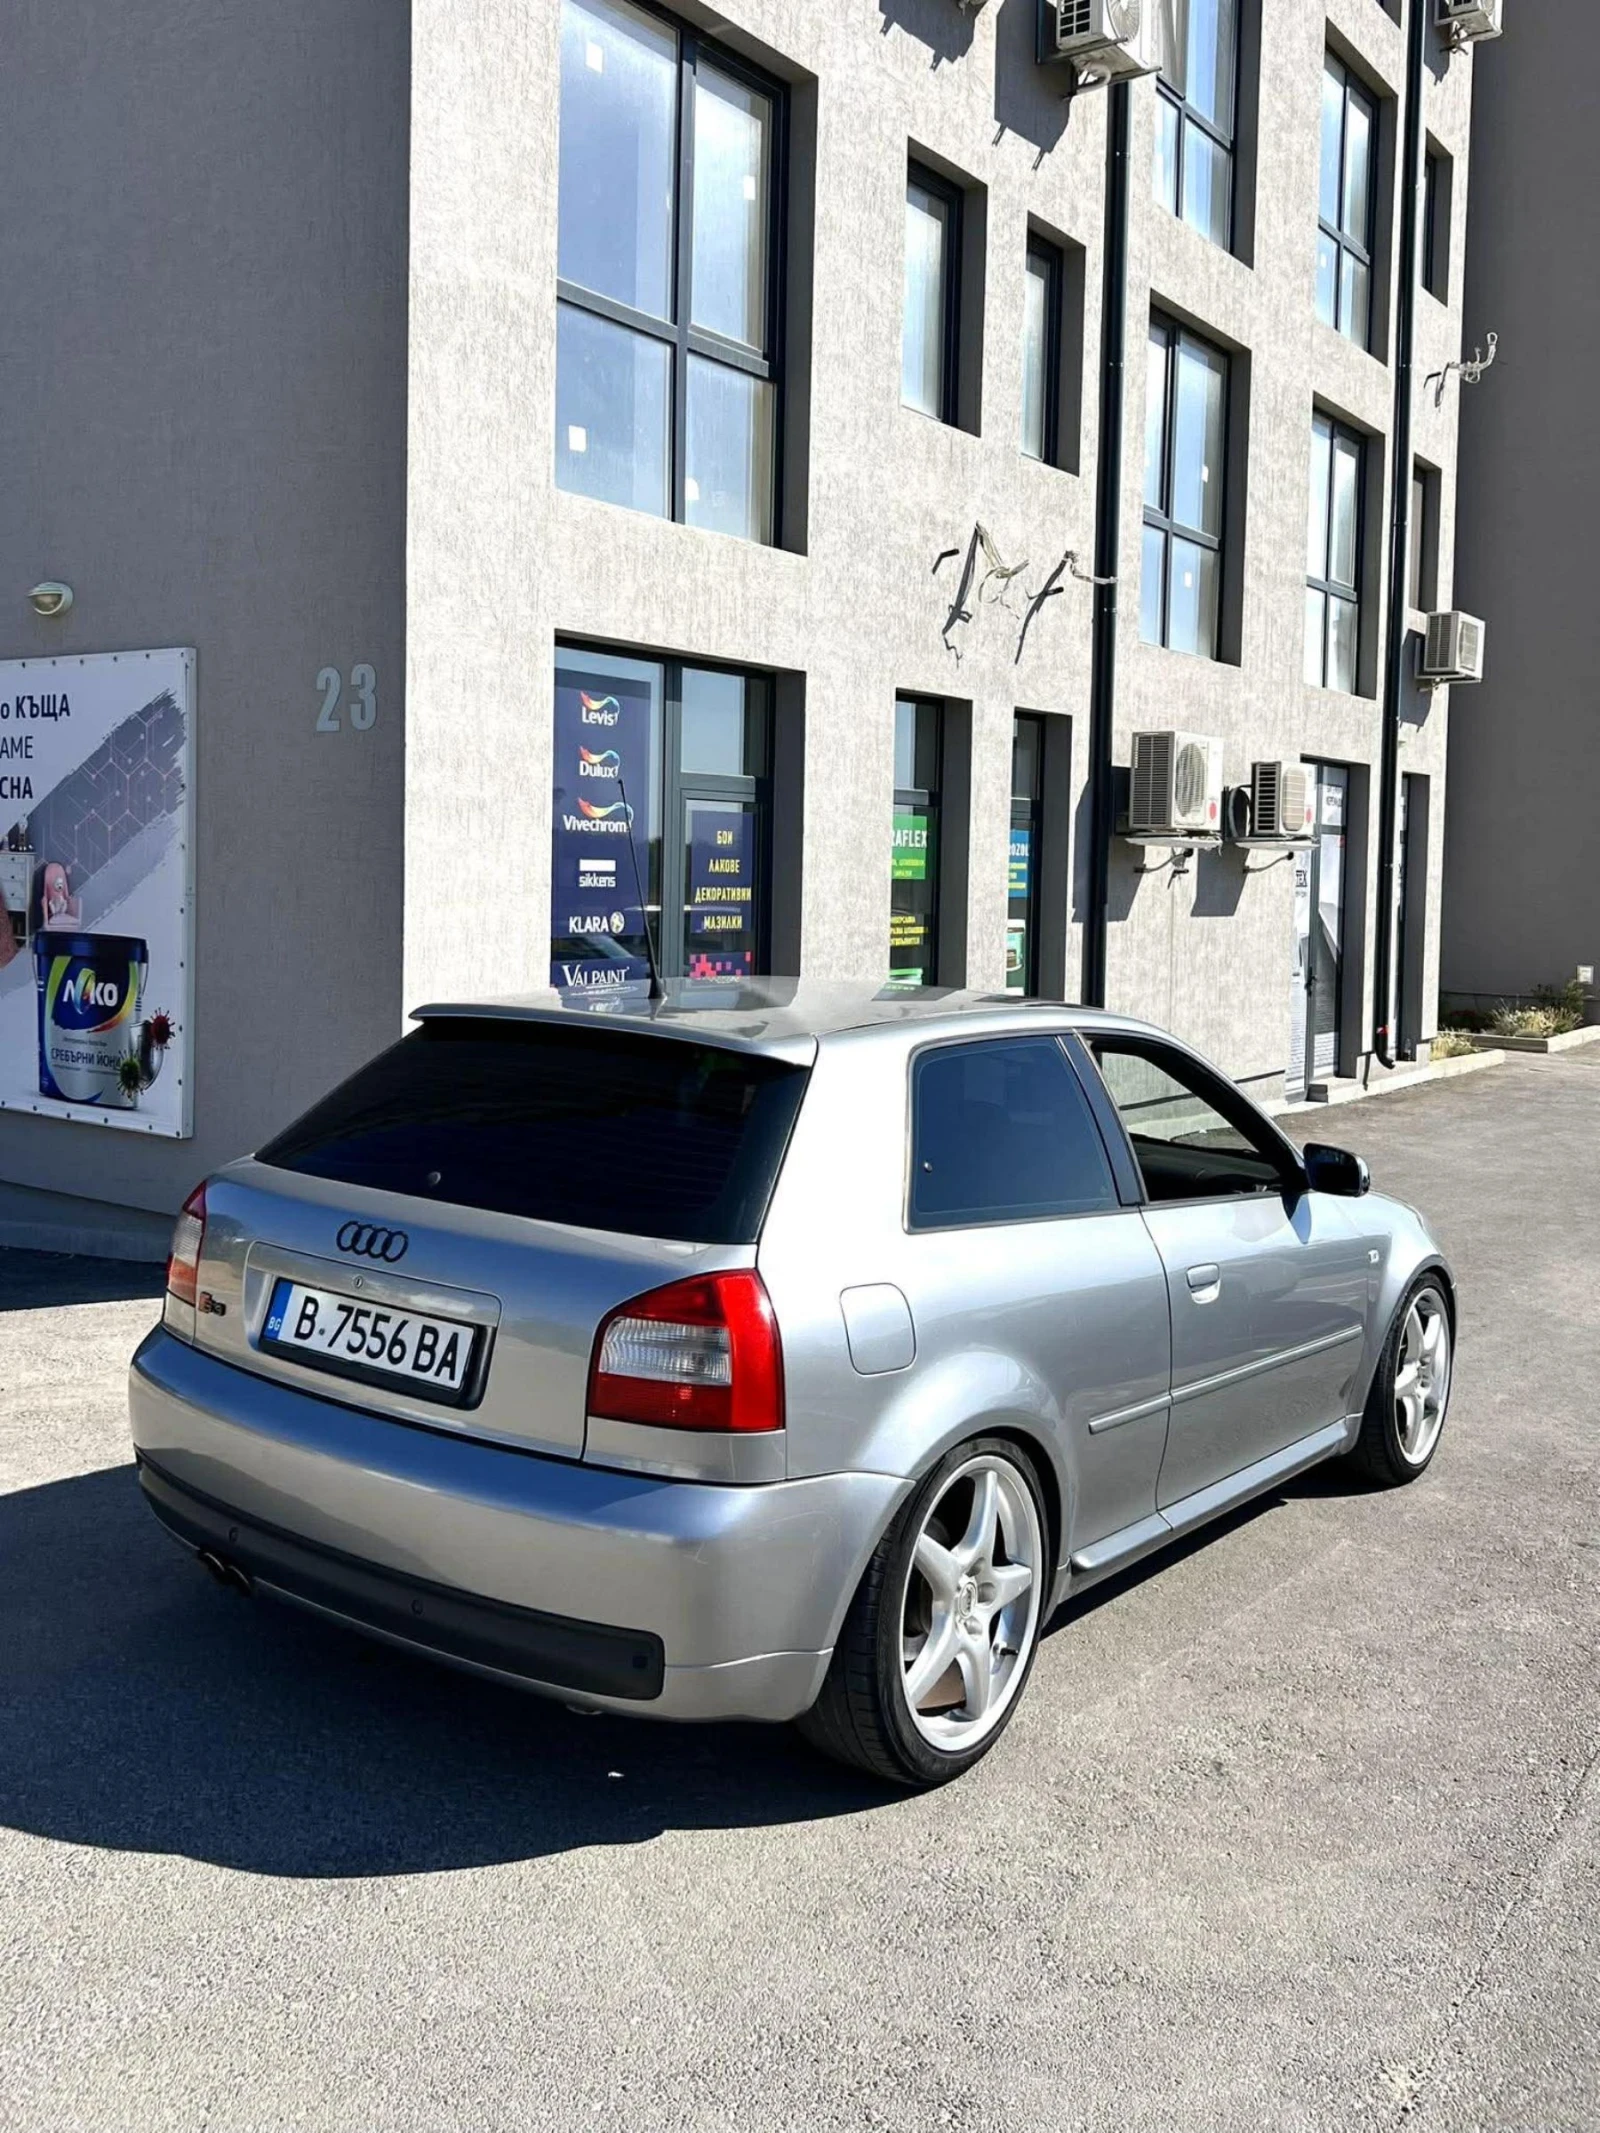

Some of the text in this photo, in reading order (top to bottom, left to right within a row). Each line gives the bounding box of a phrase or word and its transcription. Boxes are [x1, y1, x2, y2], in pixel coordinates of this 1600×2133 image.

[314, 662, 378, 732] 23
[16, 693, 71, 722] КЪЩА
[579, 760, 615, 779] Dulux
[562, 814, 628, 833] Vivechrom
[716, 830, 733, 845] БОИ
[708, 859, 741, 874] ЛАКОВЕ
[579, 873, 617, 888] sikkens
[568, 916, 609, 934] KLARA
[703, 916, 743, 930] МАЗИЛКИ
[51, 1047, 95, 1065] СРЕБЪРНИ
[267, 1315, 282, 1332] BG
[294, 1295, 461, 1382] B 7556 BA
